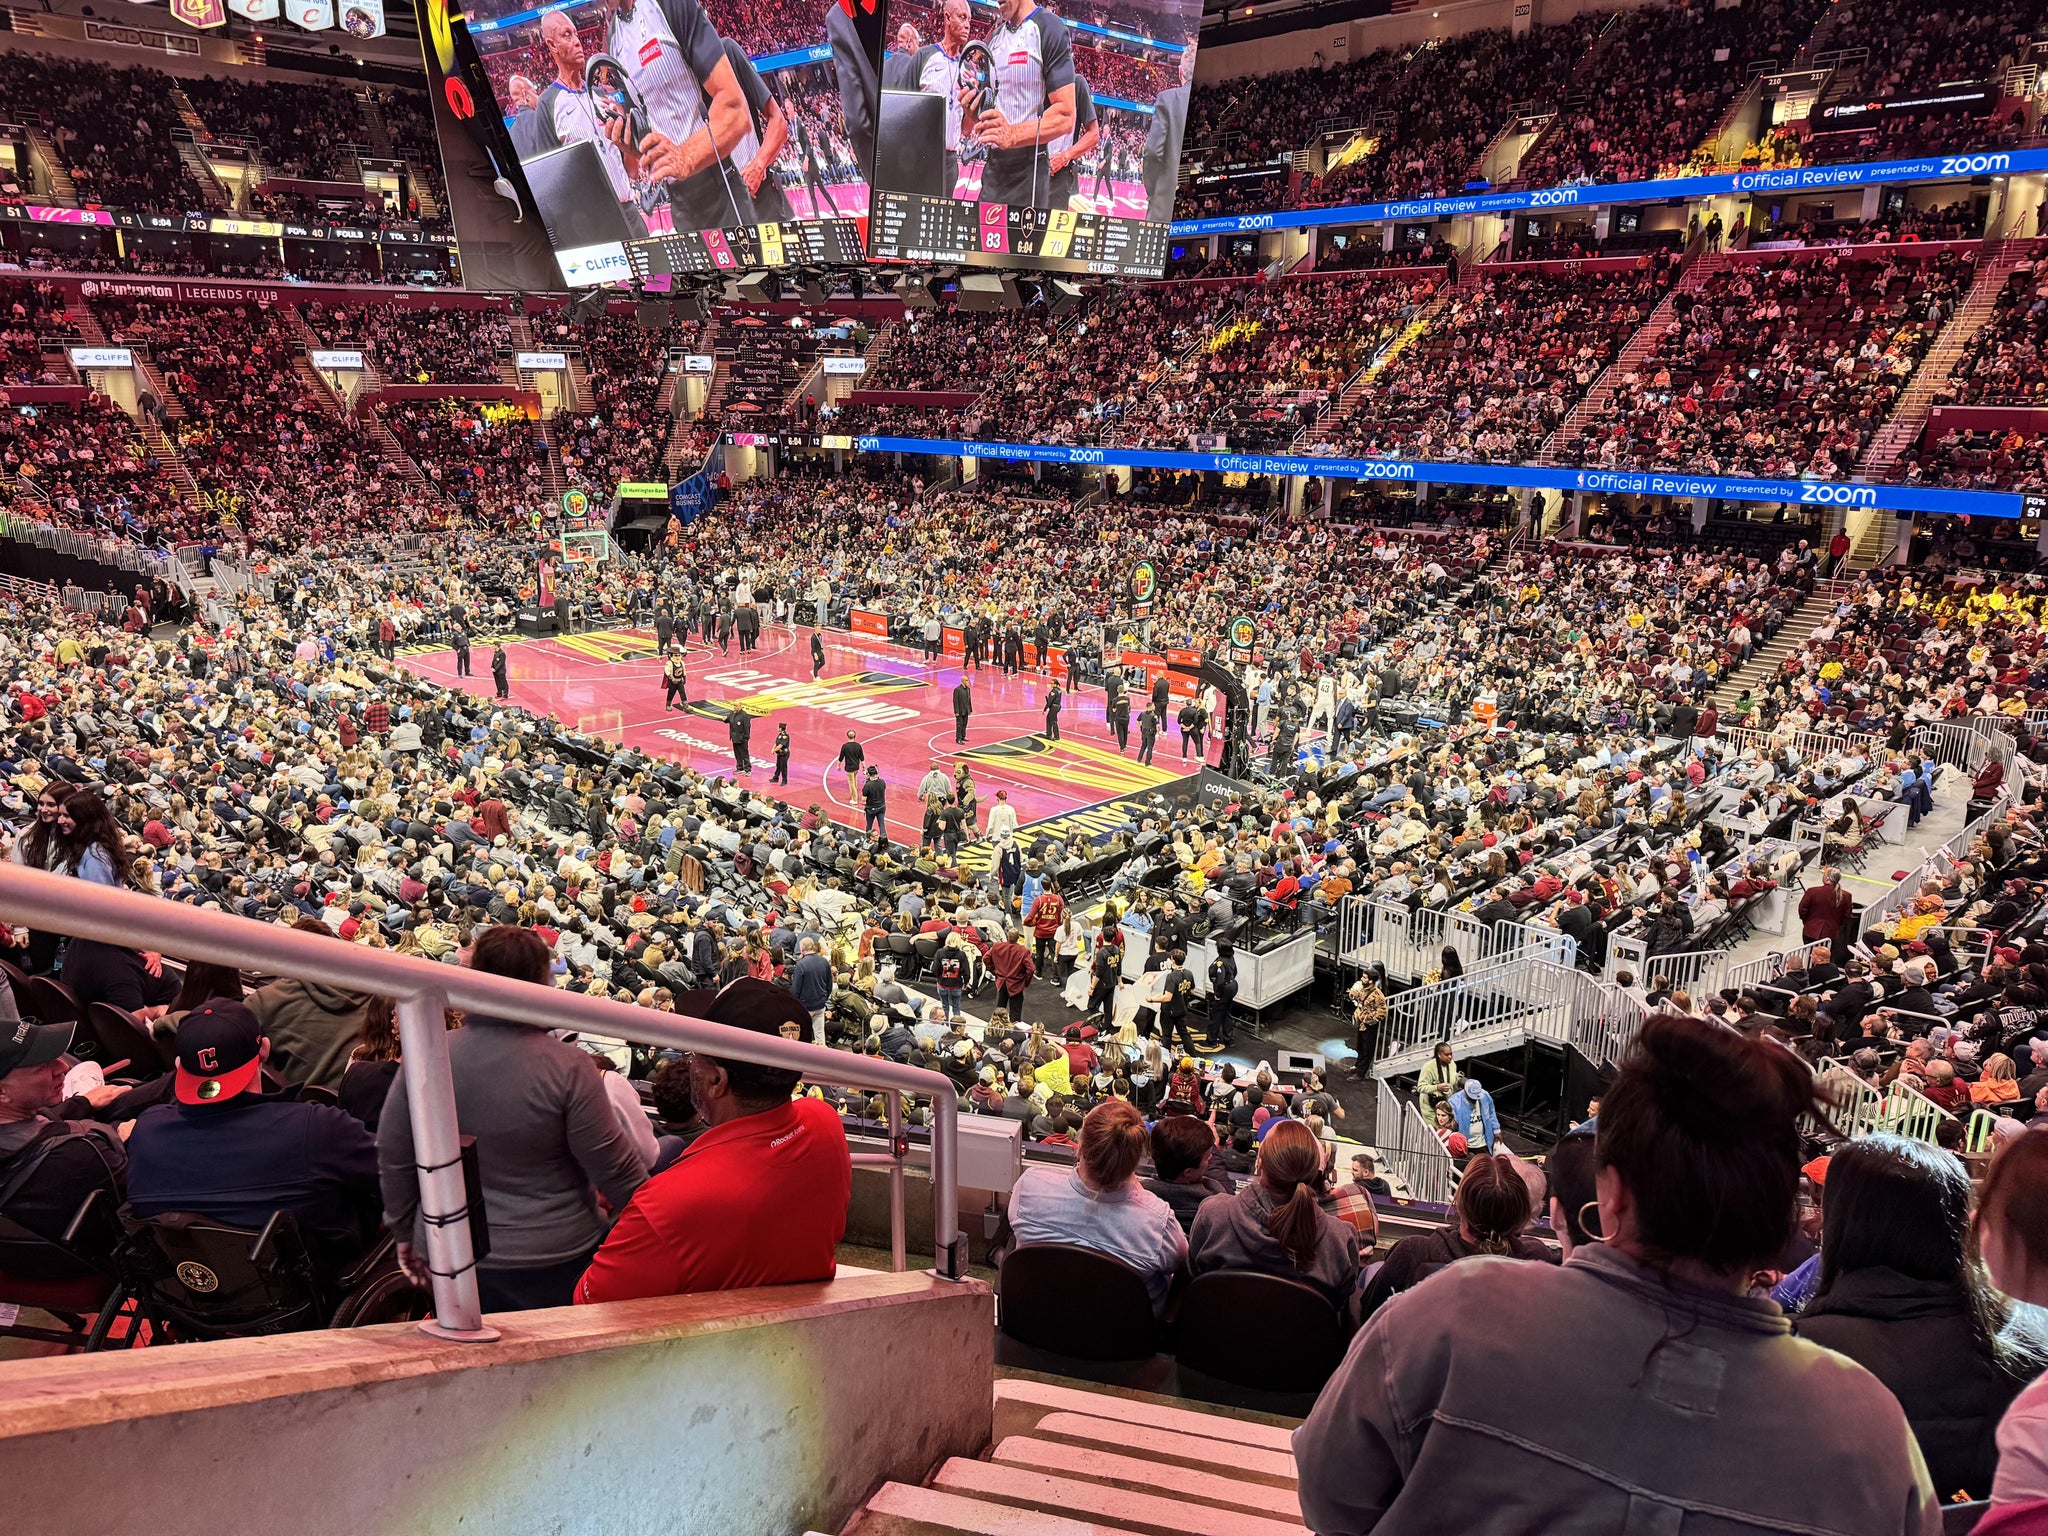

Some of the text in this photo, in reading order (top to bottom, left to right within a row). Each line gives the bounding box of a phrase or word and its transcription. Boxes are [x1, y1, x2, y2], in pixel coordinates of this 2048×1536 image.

[1516, 6, 1530, 16] 209
[88, 22, 199, 53] LOUDVILLE
[1334, 38, 1346, 46] 208
[1742, 154, 2010, 190] Official Review presented by zoom
[1391, 190, 1578, 216] Official Review presented by zoom
[6, 206, 21, 218] 51
[80, 211, 97, 223] 83
[1008, 211, 1046, 225] 3Q 12
[120, 216, 132, 225] 12
[152, 218, 172, 228] 6:04
[190, 220, 208, 230] 3Q
[1227, 220, 1236, 228] by
[1238, 215, 1273, 229] zoom
[287, 227, 324, 238] FG% 40
[336, 230, 378, 240] FOULS 2
[390, 232, 419, 242] TOL 3
[430, 234, 446, 242] 8:51
[750, 228, 757, 239] 12
[986, 232, 1001, 249] 83
[1017, 240, 1034, 254] 6:04
[586, 254, 628, 271] CLIFFS
[716, 251, 730, 265] 83
[934, 252, 966, 262] RAFFLE
[101, 281, 278, 301] Huntington LEGENDS CLUB
[95, 353, 130, 362] CLIFFS
[332, 356, 361, 364] CLIFFS
[754, 436, 765, 444] 83
[788, 436, 802, 446] 6:04
[812, 438, 820, 446] 12
[968, 444, 998, 456] Official
[1000, 446, 1030, 458] Review
[1069, 450, 1104, 462] zoom
[1221, 458, 1414, 478] Official Review presented by zoom
[1588, 474, 1876, 505] Official Review presented by zoom
[2026, 497, 2046, 506] FG%
[2026, 508, 2040, 518] 51
[1137, 579, 1148, 596] 12
[702, 670, 921, 724] CLEVELAND
[665, 732, 730, 753] Rocket
[1040, 902, 1058, 915] 45
[1160, 957, 1172, 971] CAV
[198, 1047, 218, 1072] C
[775, 1130, 794, 1146] Rocket
